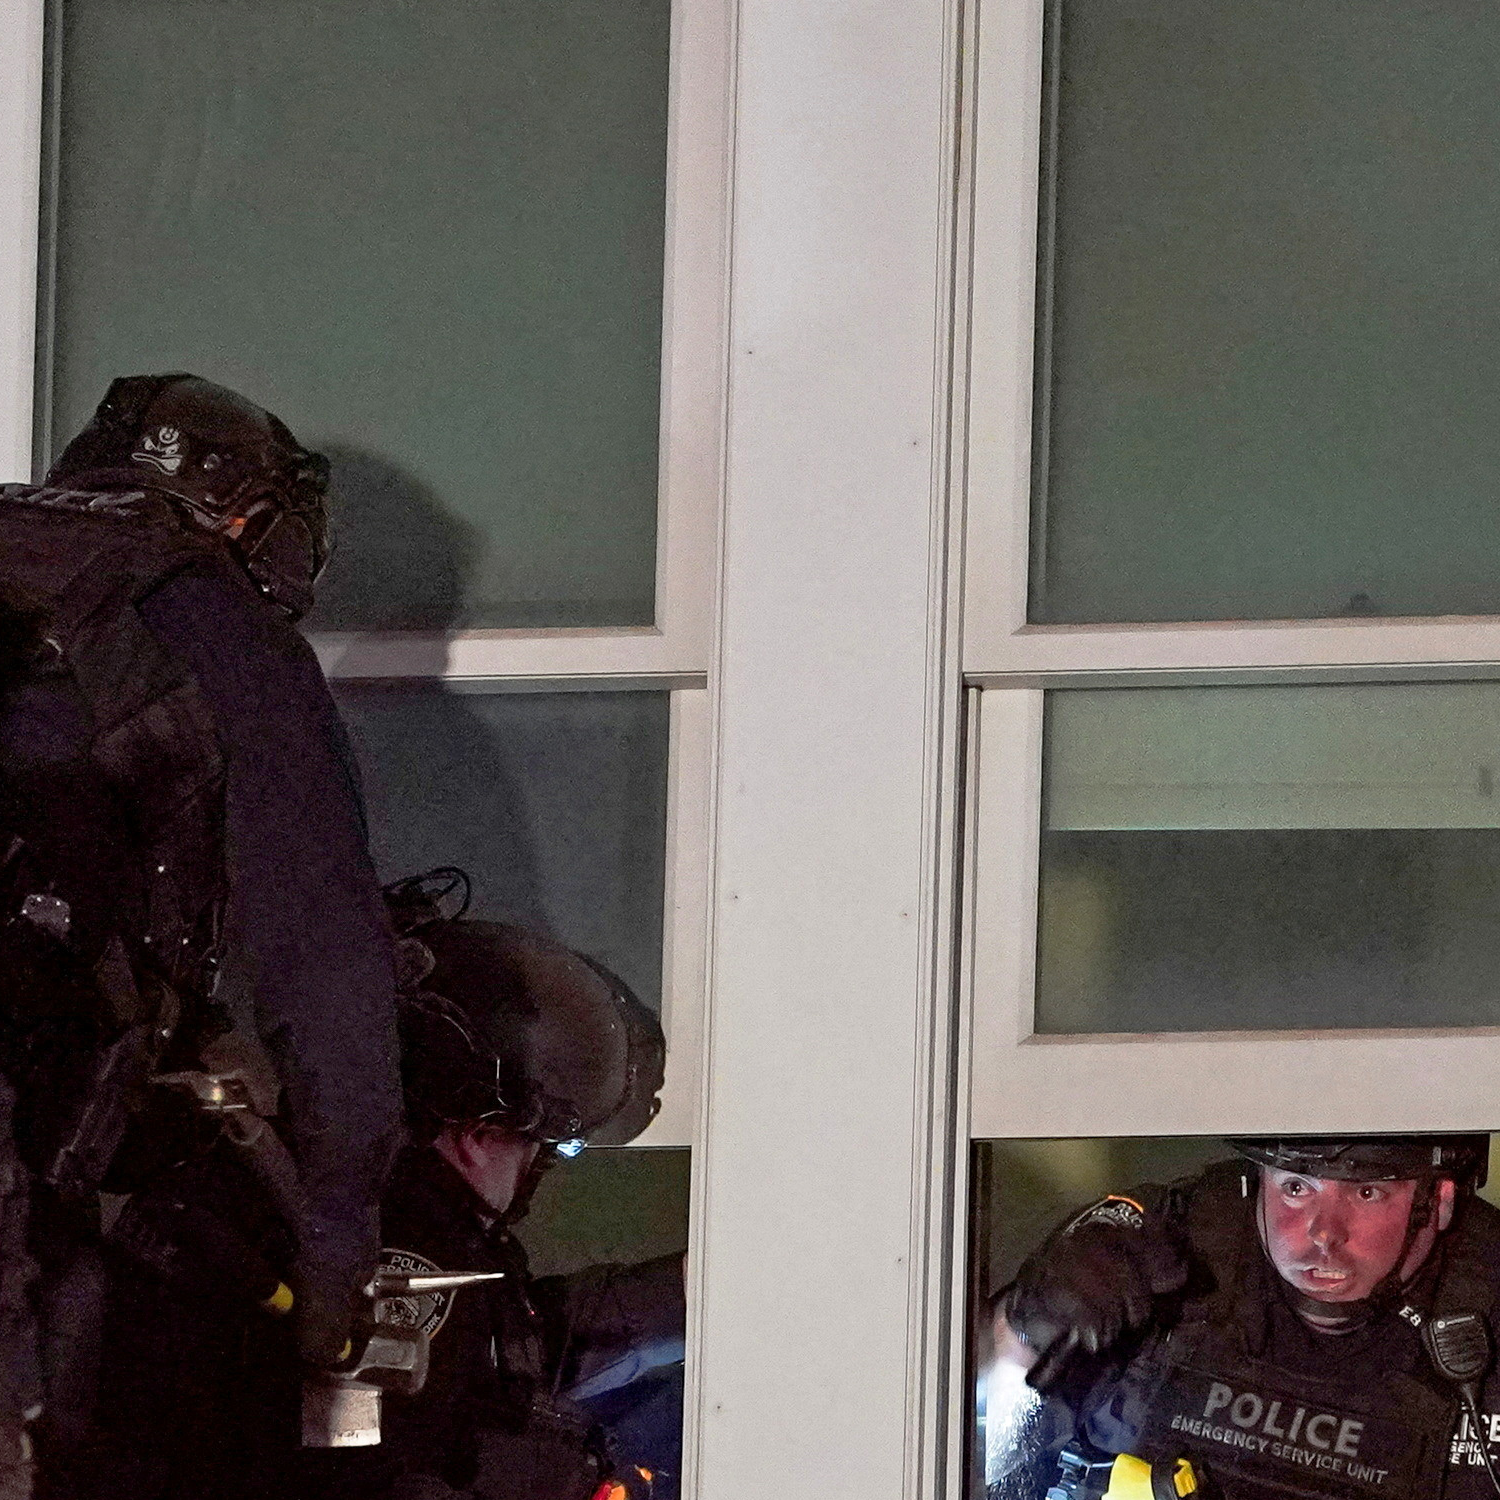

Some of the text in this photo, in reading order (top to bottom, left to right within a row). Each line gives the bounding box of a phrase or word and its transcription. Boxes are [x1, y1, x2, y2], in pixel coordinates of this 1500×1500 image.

[422, 1313, 441, 1334] ORK
[1171, 1414, 1388, 1484] EMERGENCY SERVICE UNIT
[1203, 1382, 1364, 1457] POLICE
